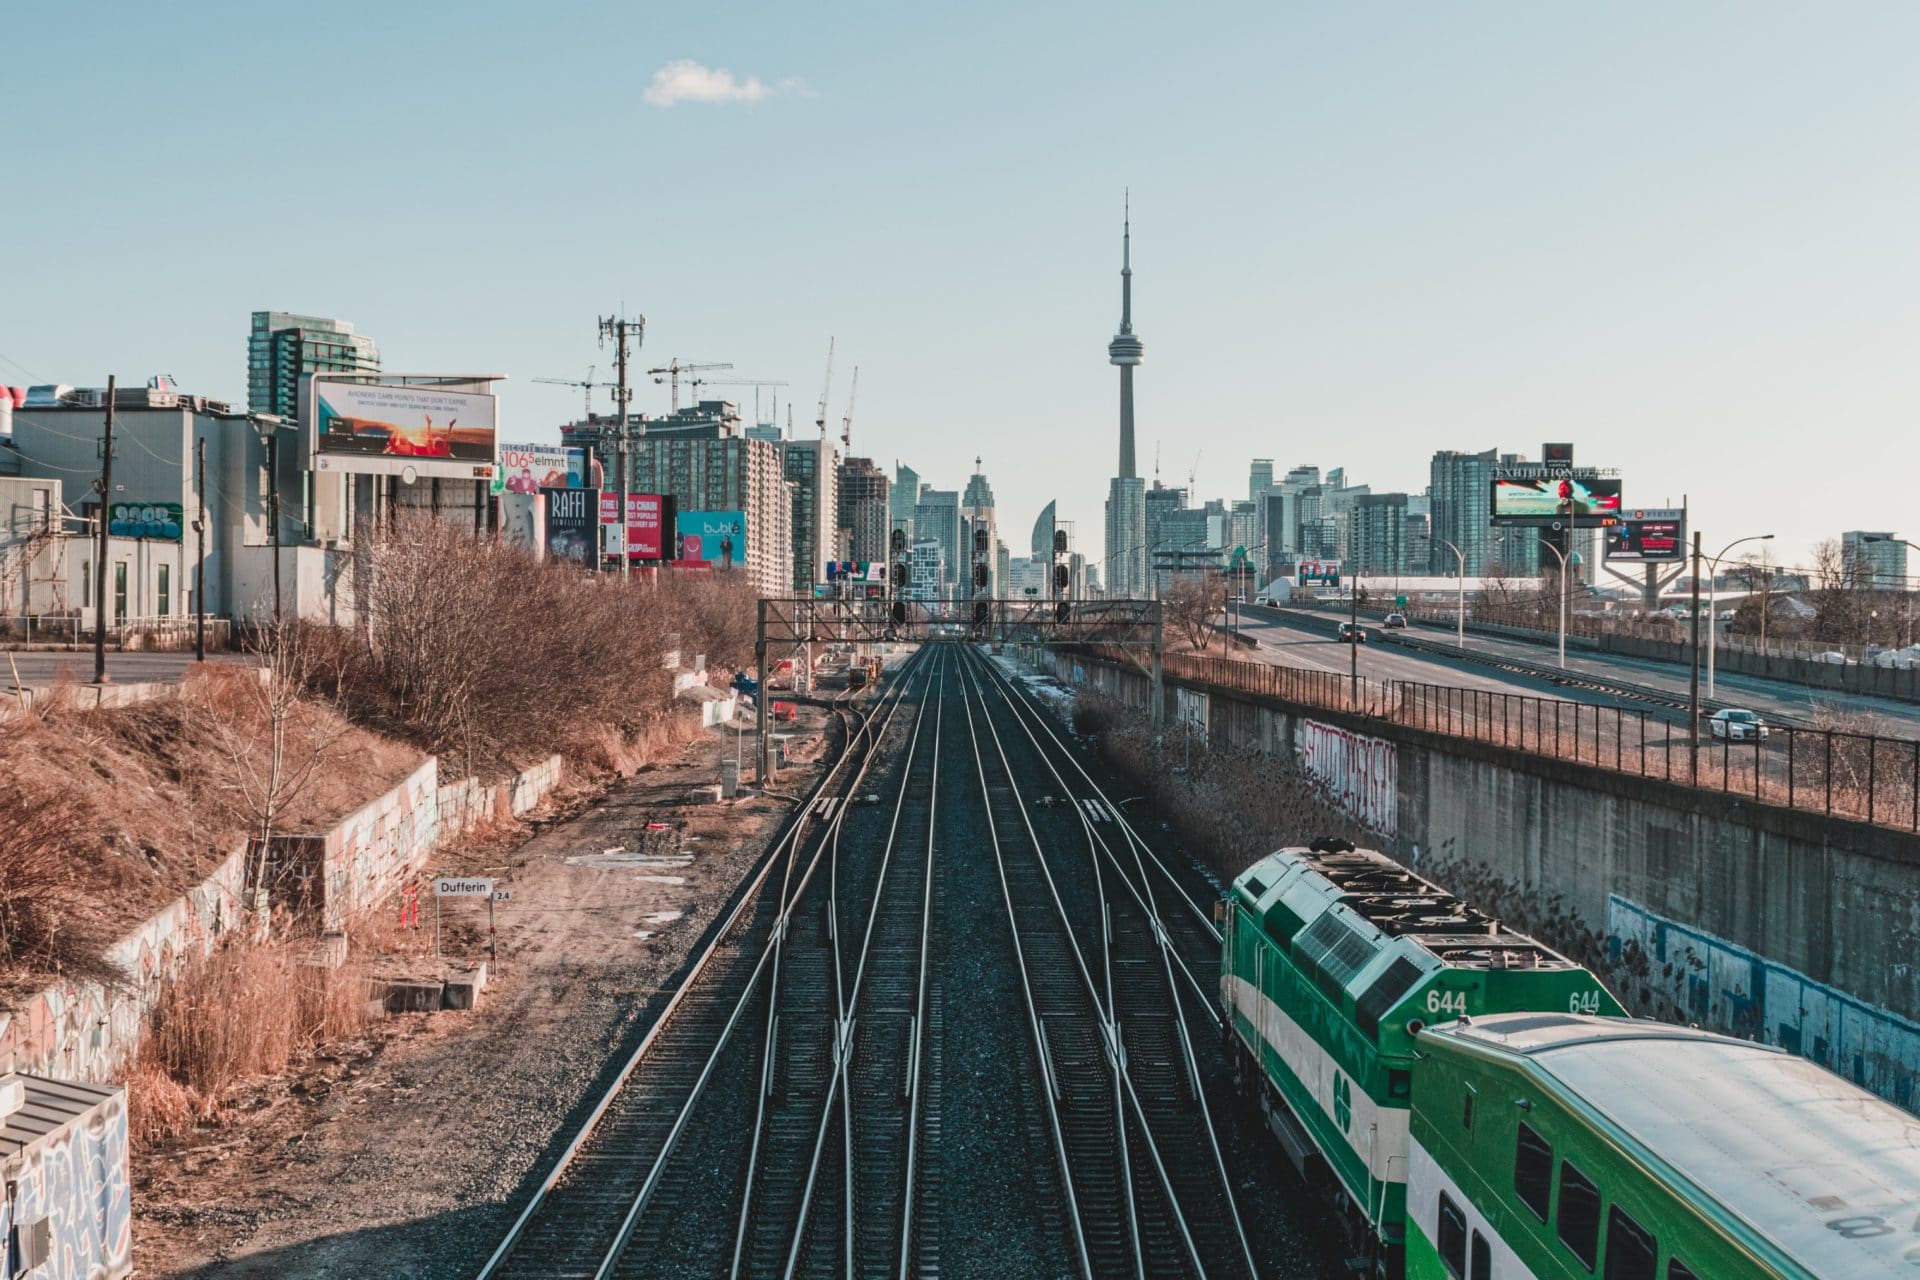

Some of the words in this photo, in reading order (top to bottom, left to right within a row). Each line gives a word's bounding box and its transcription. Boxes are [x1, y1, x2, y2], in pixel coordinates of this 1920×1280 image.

[1496, 467, 1574, 478] EXHIBITION
[551, 491, 585, 518] RAFFI
[602, 500, 616, 510] THE
[637, 501, 657, 511] CHAIN
[441, 882, 486, 893] Dufferin
[1427, 989, 1467, 1014] 644
[1569, 989, 1600, 1014] 644
